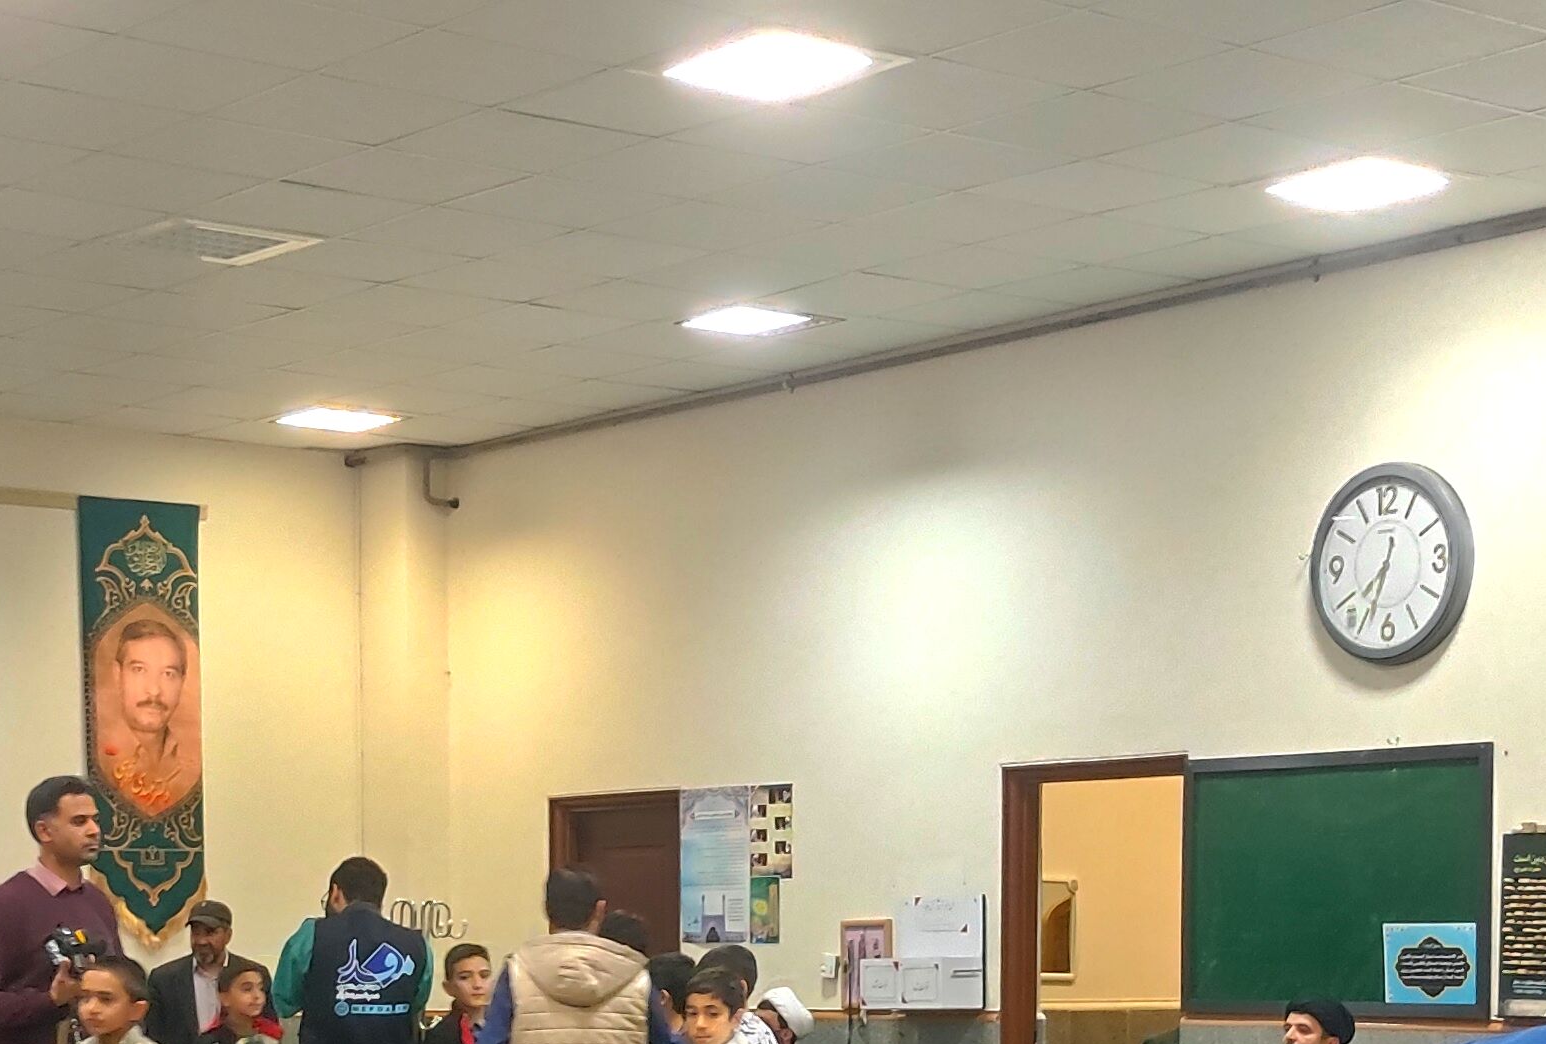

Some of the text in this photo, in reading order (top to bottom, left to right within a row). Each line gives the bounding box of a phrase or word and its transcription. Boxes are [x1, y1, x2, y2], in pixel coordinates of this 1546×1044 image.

[1375, 486, 1398, 516] 12
[1328, 555, 1345, 585] 9
[1431, 543, 1447, 574] 3
[1380, 612, 1396, 642] 6
